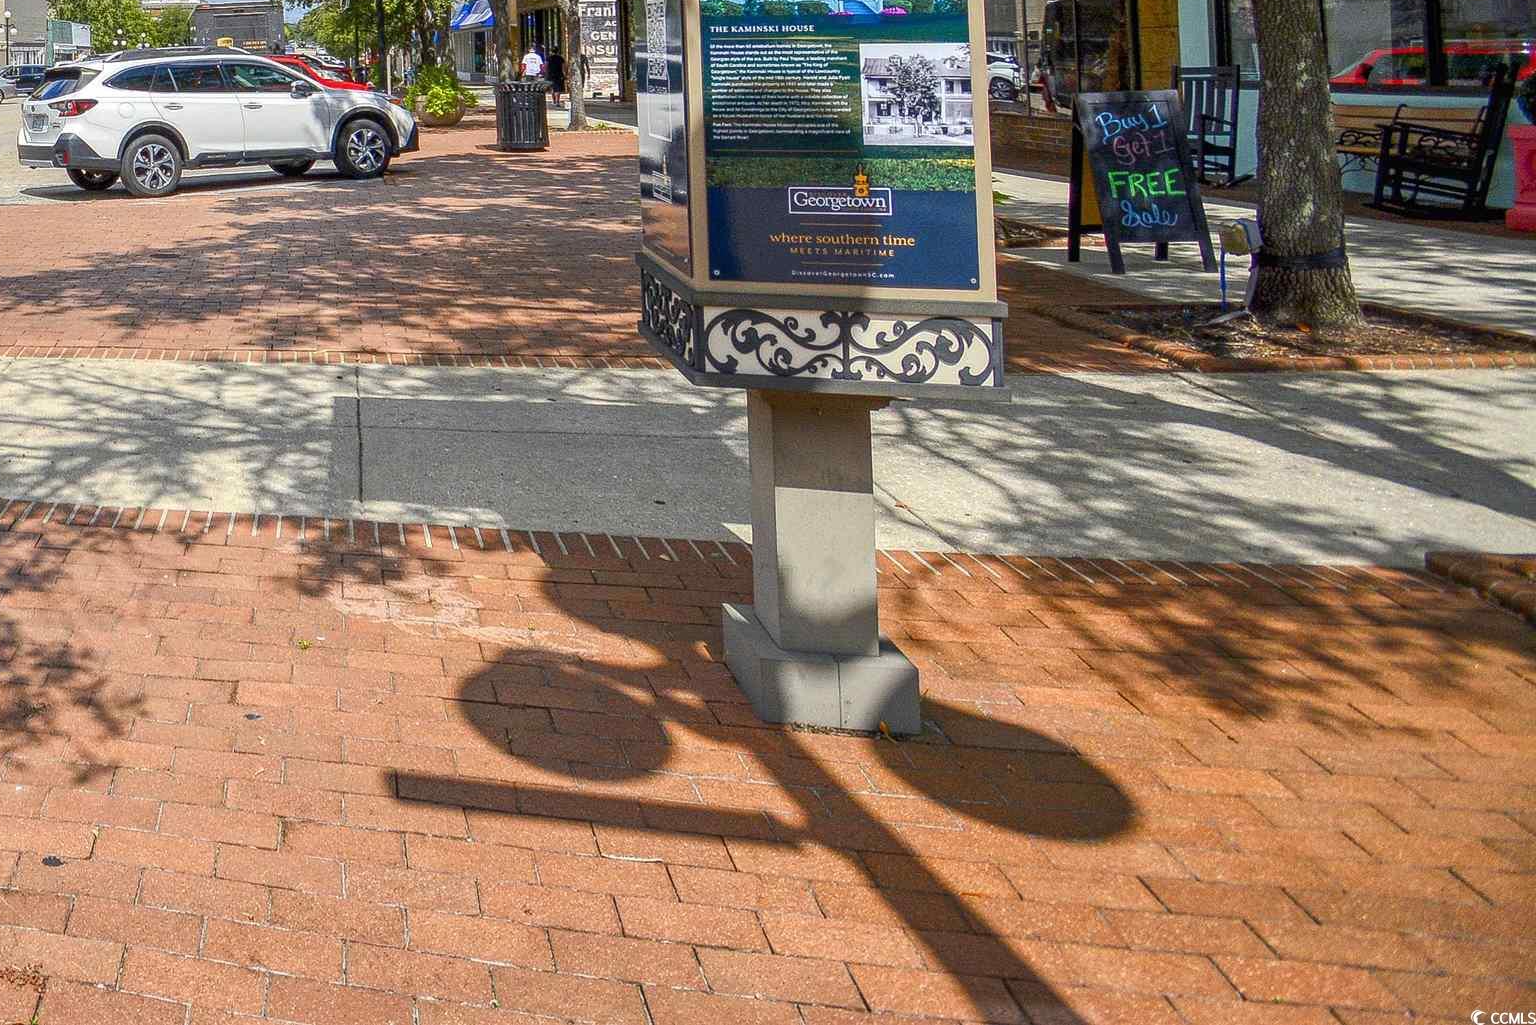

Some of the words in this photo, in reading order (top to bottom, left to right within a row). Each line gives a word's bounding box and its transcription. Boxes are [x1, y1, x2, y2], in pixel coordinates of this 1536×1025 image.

[710, 25, 728, 33] THE
[731, 25, 779, 33] KAMINSKI
[782, 24, 815, 32] HOUSE
[1095, 111, 1150, 145] Buy
[1148, 103, 1168, 129] 1
[1113, 132, 1152, 166] Get
[1153, 129, 1176, 155] 1
[1107, 168, 1187, 198] FREE
[793, 191, 887, 211] Georgetown
[1120, 199, 1178, 229] Sale
[769, 232, 813, 244] where
[815, 233, 880, 246] southern
[882, 234, 915, 247] time
[834, 248, 896, 257] MARITIME
